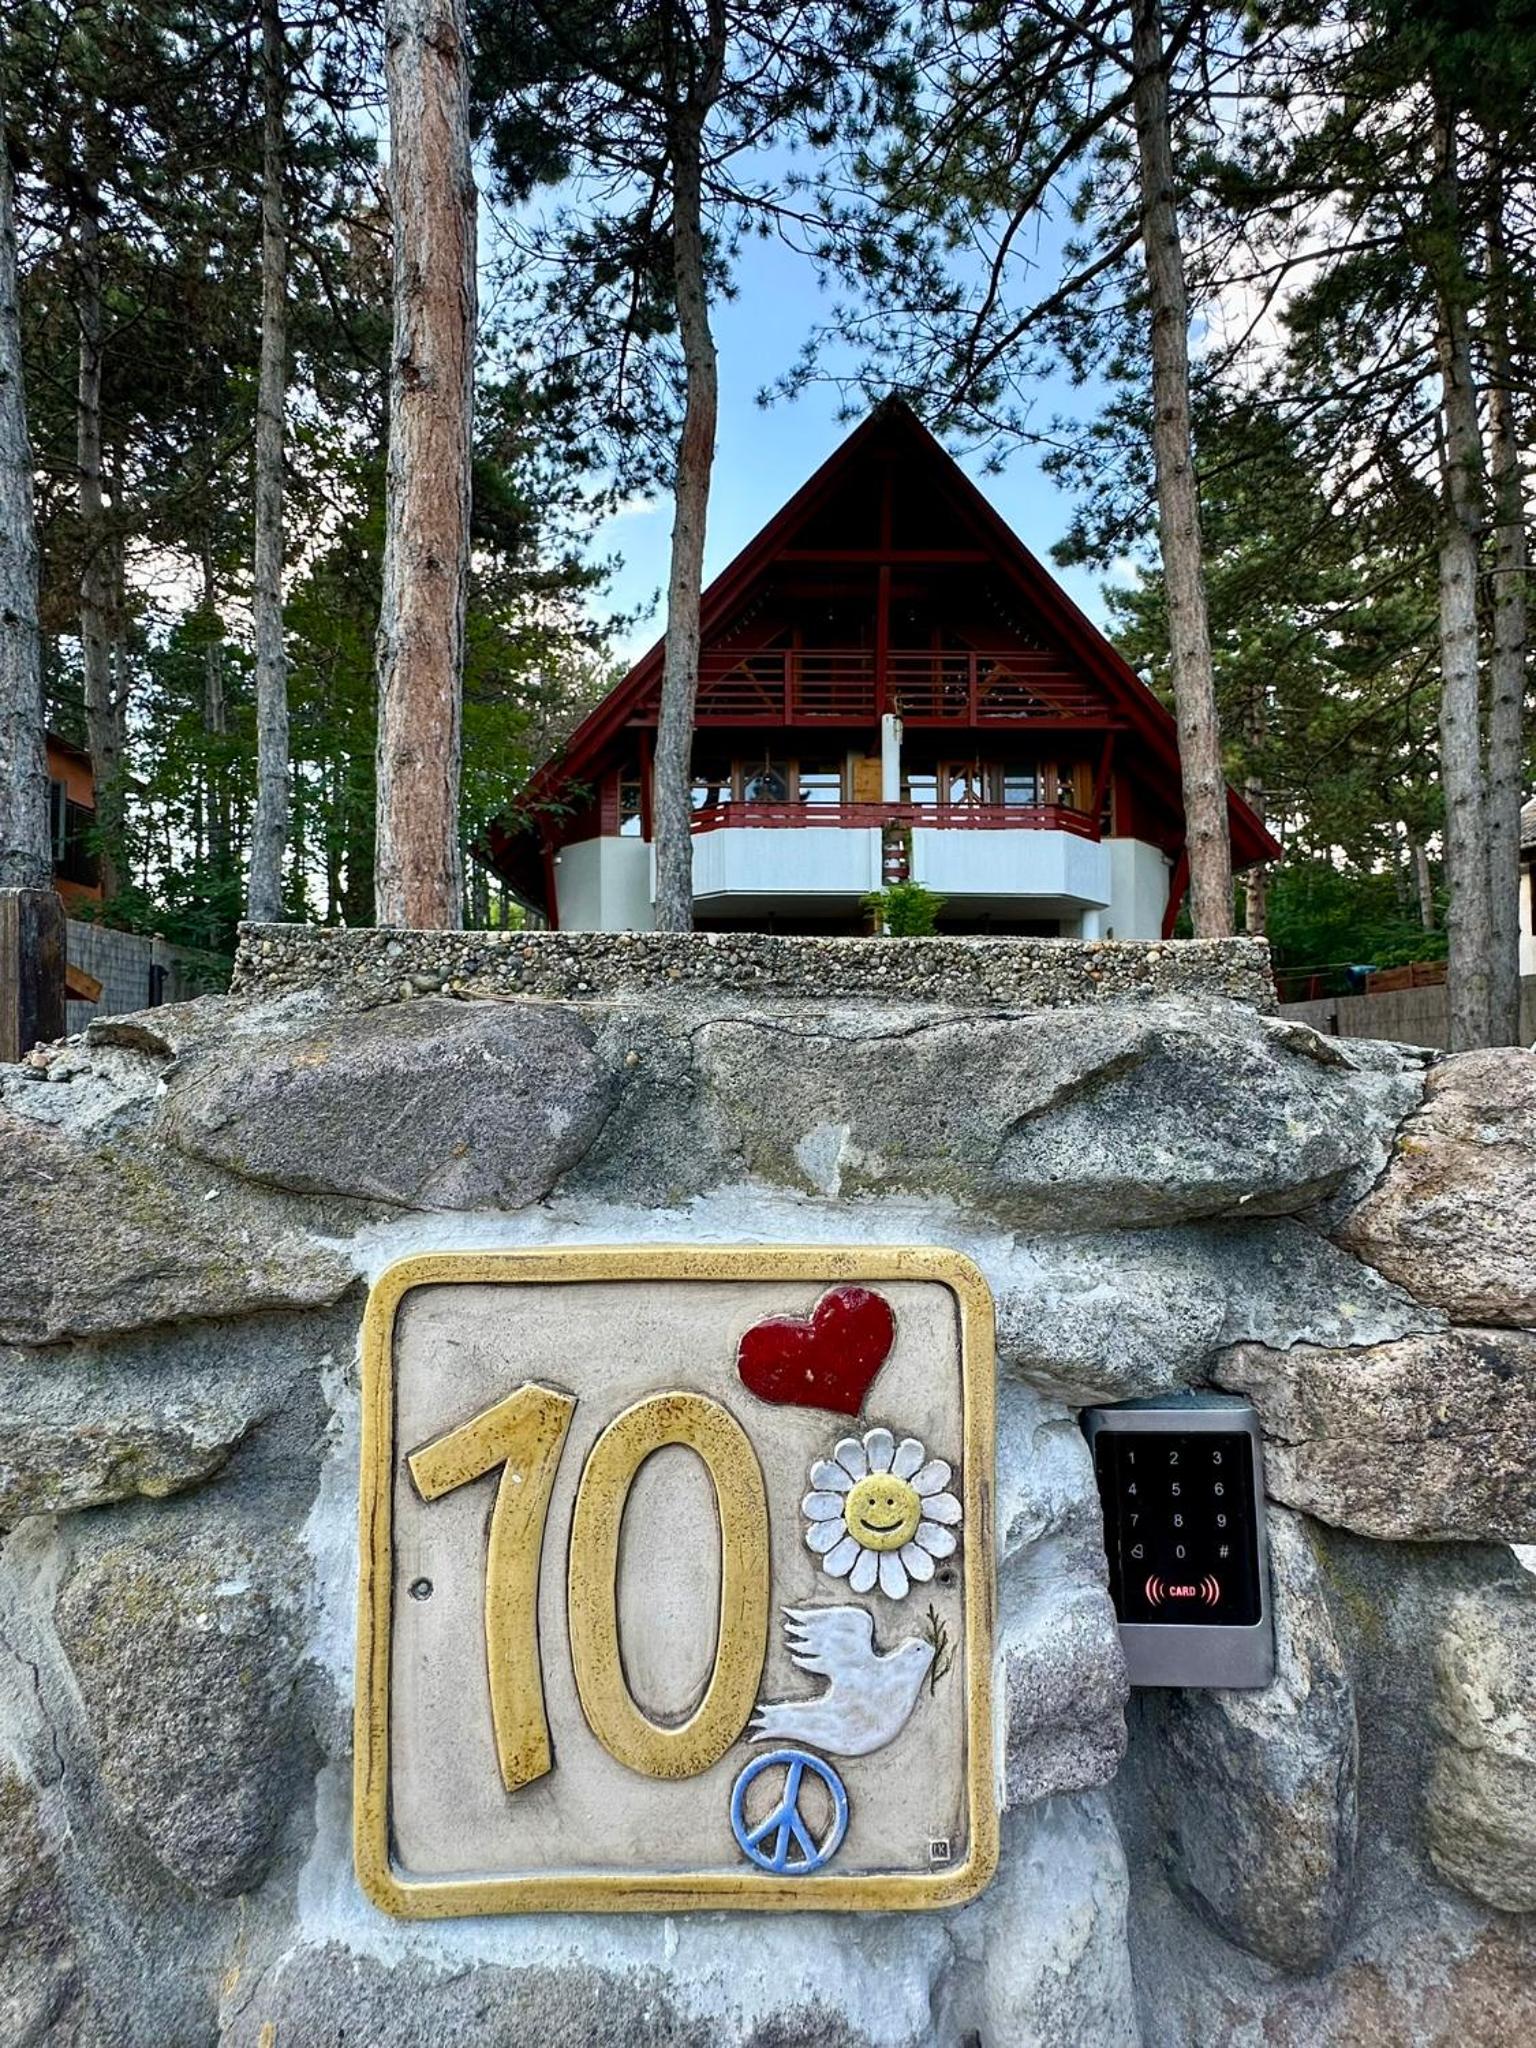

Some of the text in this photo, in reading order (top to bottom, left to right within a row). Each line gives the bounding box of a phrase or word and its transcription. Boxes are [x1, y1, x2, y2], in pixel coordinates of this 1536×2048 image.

[1128, 1451, 1222, 1465] 1 2 3
[1128, 1482, 1224, 1496] 4 5 6
[1130, 1513, 1227, 1527] 7 8 9
[1176, 1544, 1186, 1559] 0
[407, 1381, 771, 1792] 10
[1169, 1585, 1197, 1598] CARD
